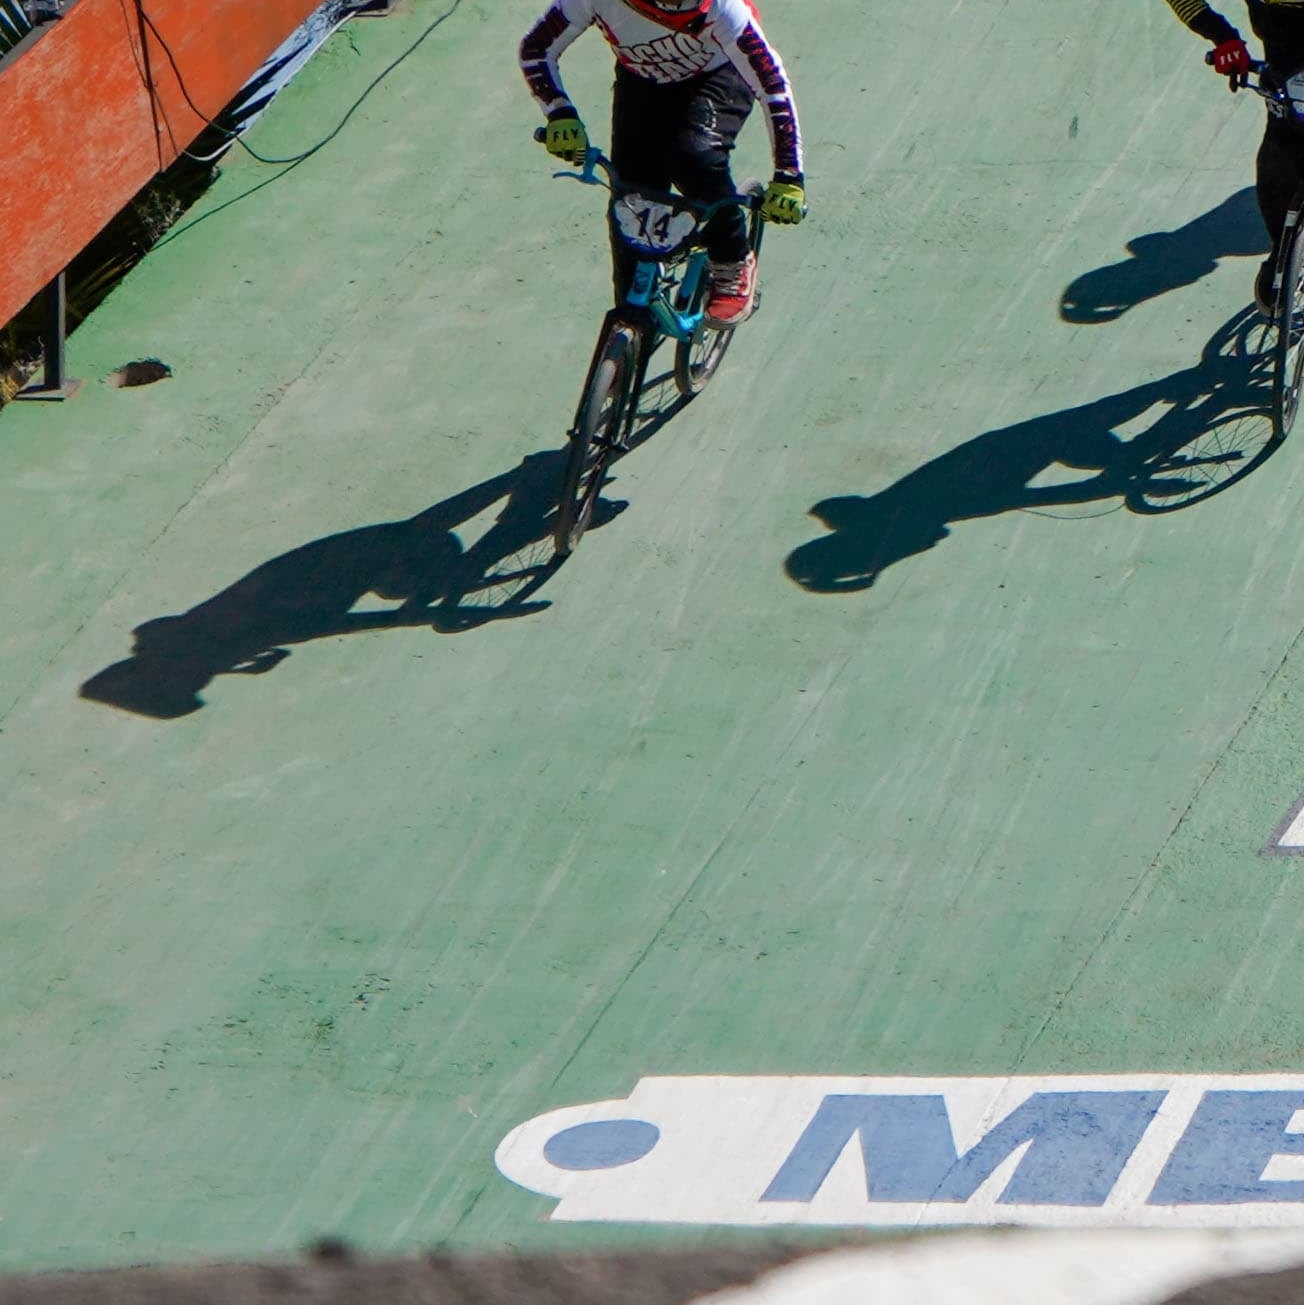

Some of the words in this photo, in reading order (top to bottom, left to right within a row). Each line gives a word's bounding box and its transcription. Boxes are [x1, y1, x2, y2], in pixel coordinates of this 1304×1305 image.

[1219, 50, 1241, 66] FLY
[553, 127, 579, 143] FLY
[769, 194, 797, 212] FLY
[638, 207, 672, 242] 14
